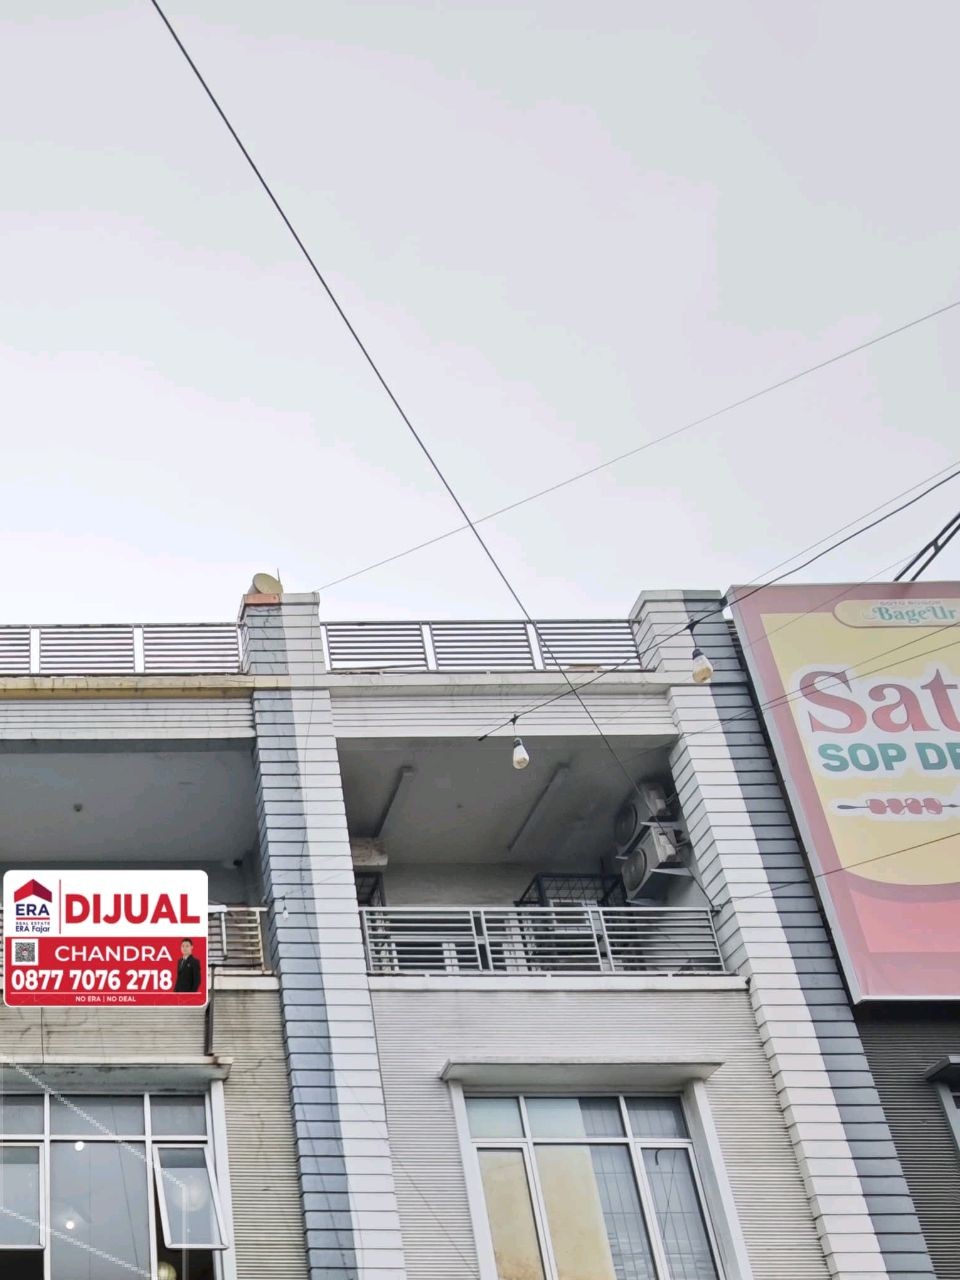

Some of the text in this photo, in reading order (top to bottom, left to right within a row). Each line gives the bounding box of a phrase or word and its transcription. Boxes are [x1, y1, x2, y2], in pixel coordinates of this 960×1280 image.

[818, 742, 907, 772] SOP
[15, 903, 50, 916] ERA
[65, 893, 200, 924] DIJUAL
[32, 925, 50, 934] Fajar
[54, 945, 173, 962] CHANDRA
[11, 969, 173, 991] 0877 7076 2718
